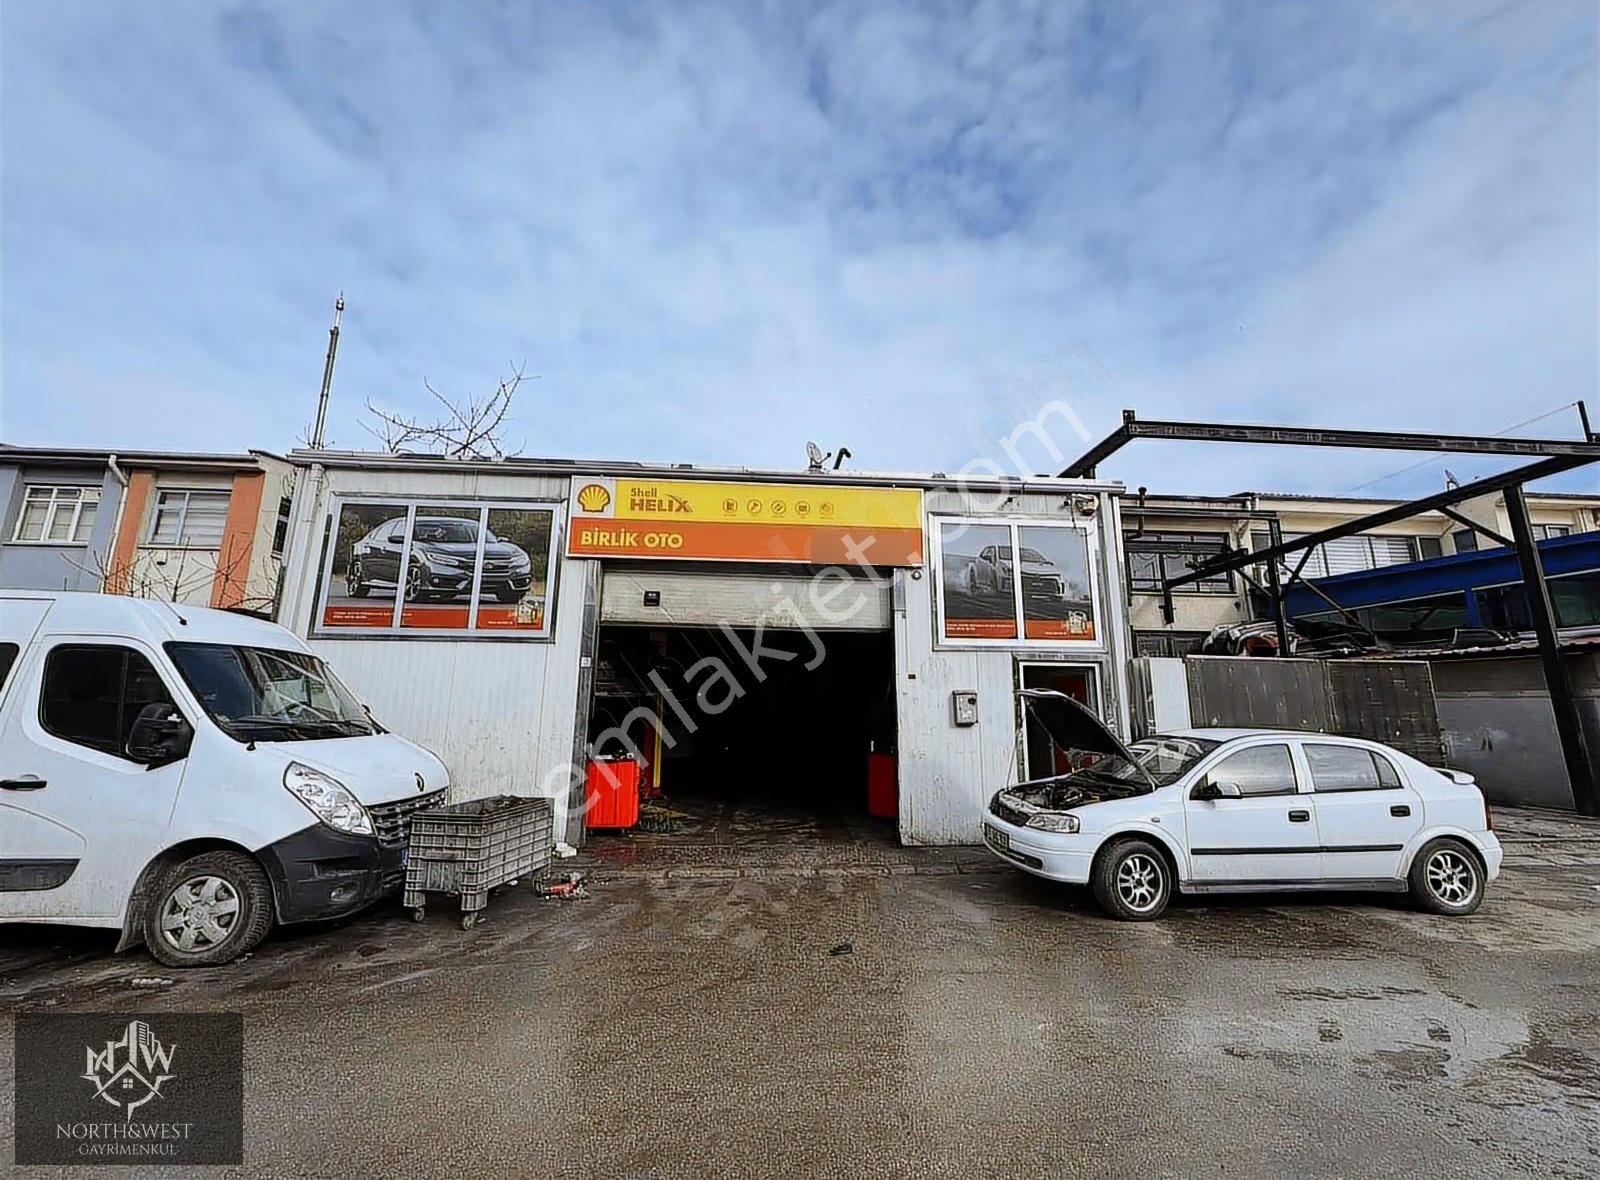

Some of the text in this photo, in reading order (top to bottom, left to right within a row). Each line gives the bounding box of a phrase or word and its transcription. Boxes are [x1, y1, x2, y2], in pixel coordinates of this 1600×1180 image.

[630, 487, 658, 498] Shell
[629, 497, 692, 513] HELIX
[580, 527, 684, 548] BİRLİK OTO
